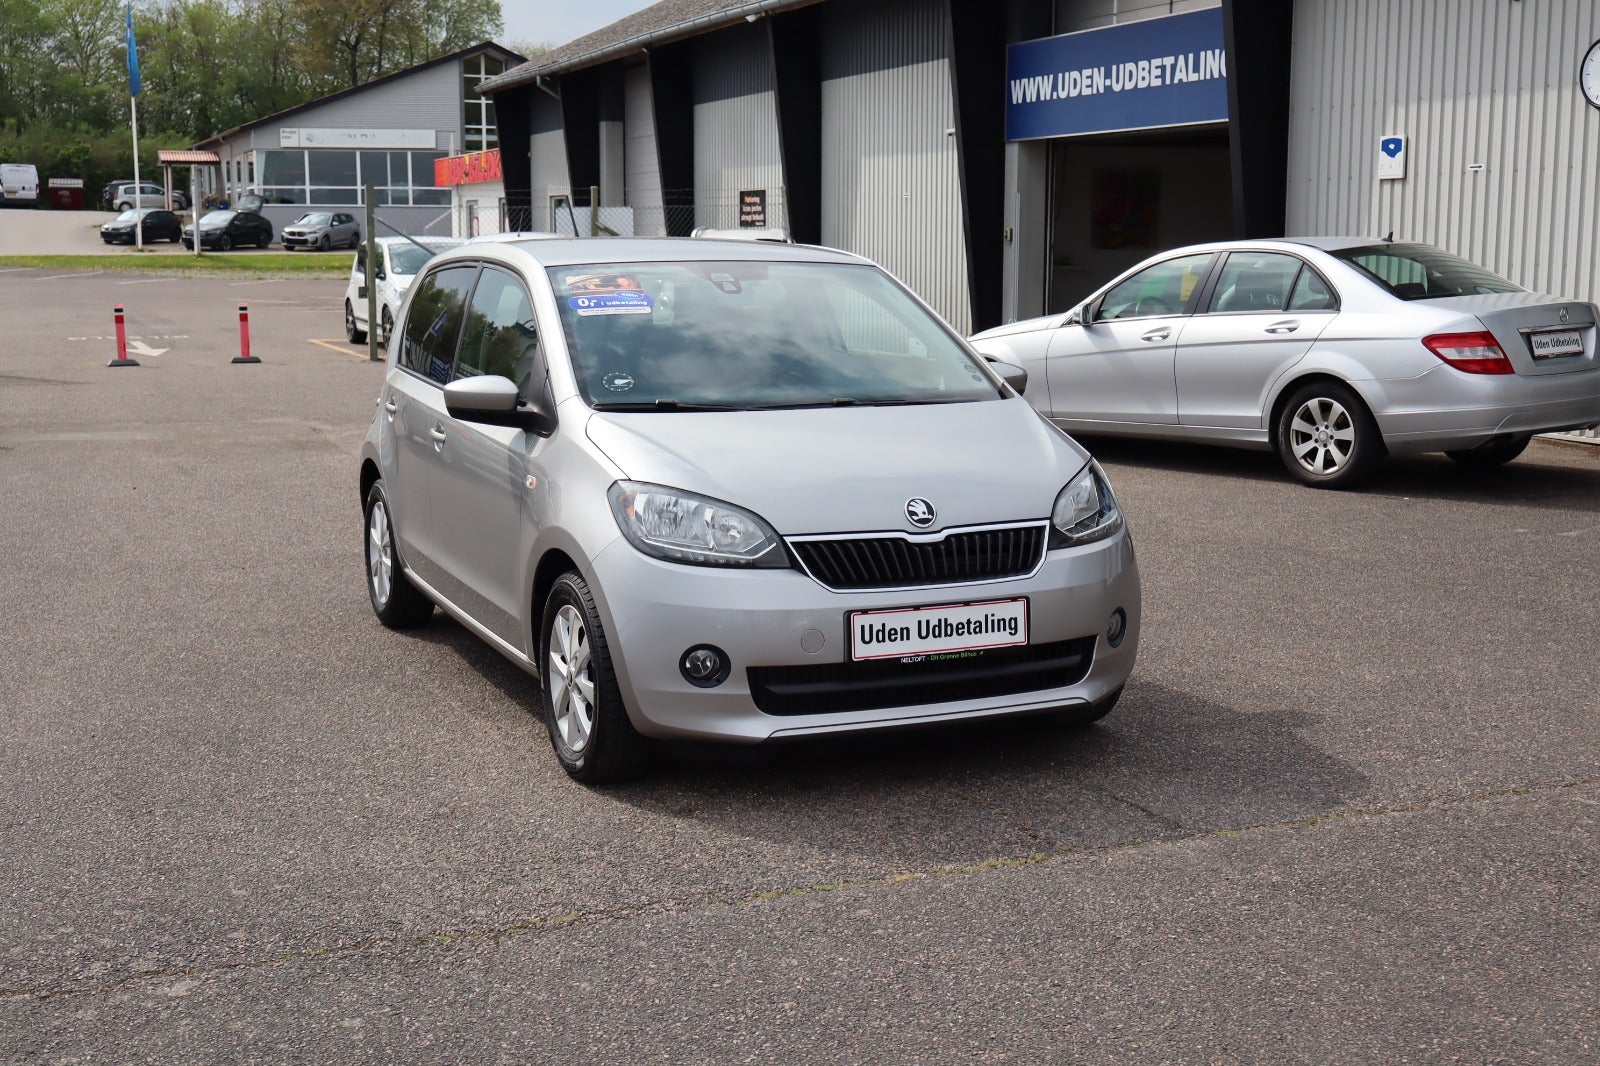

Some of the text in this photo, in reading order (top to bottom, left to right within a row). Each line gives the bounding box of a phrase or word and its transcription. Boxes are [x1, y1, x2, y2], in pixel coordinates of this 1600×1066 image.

[1534, 337, 1580, 350] Uden Udbetaling
[860, 613, 1018, 645] Uden Udbetaling
[900, 655, 926, 664] NELTOFT
